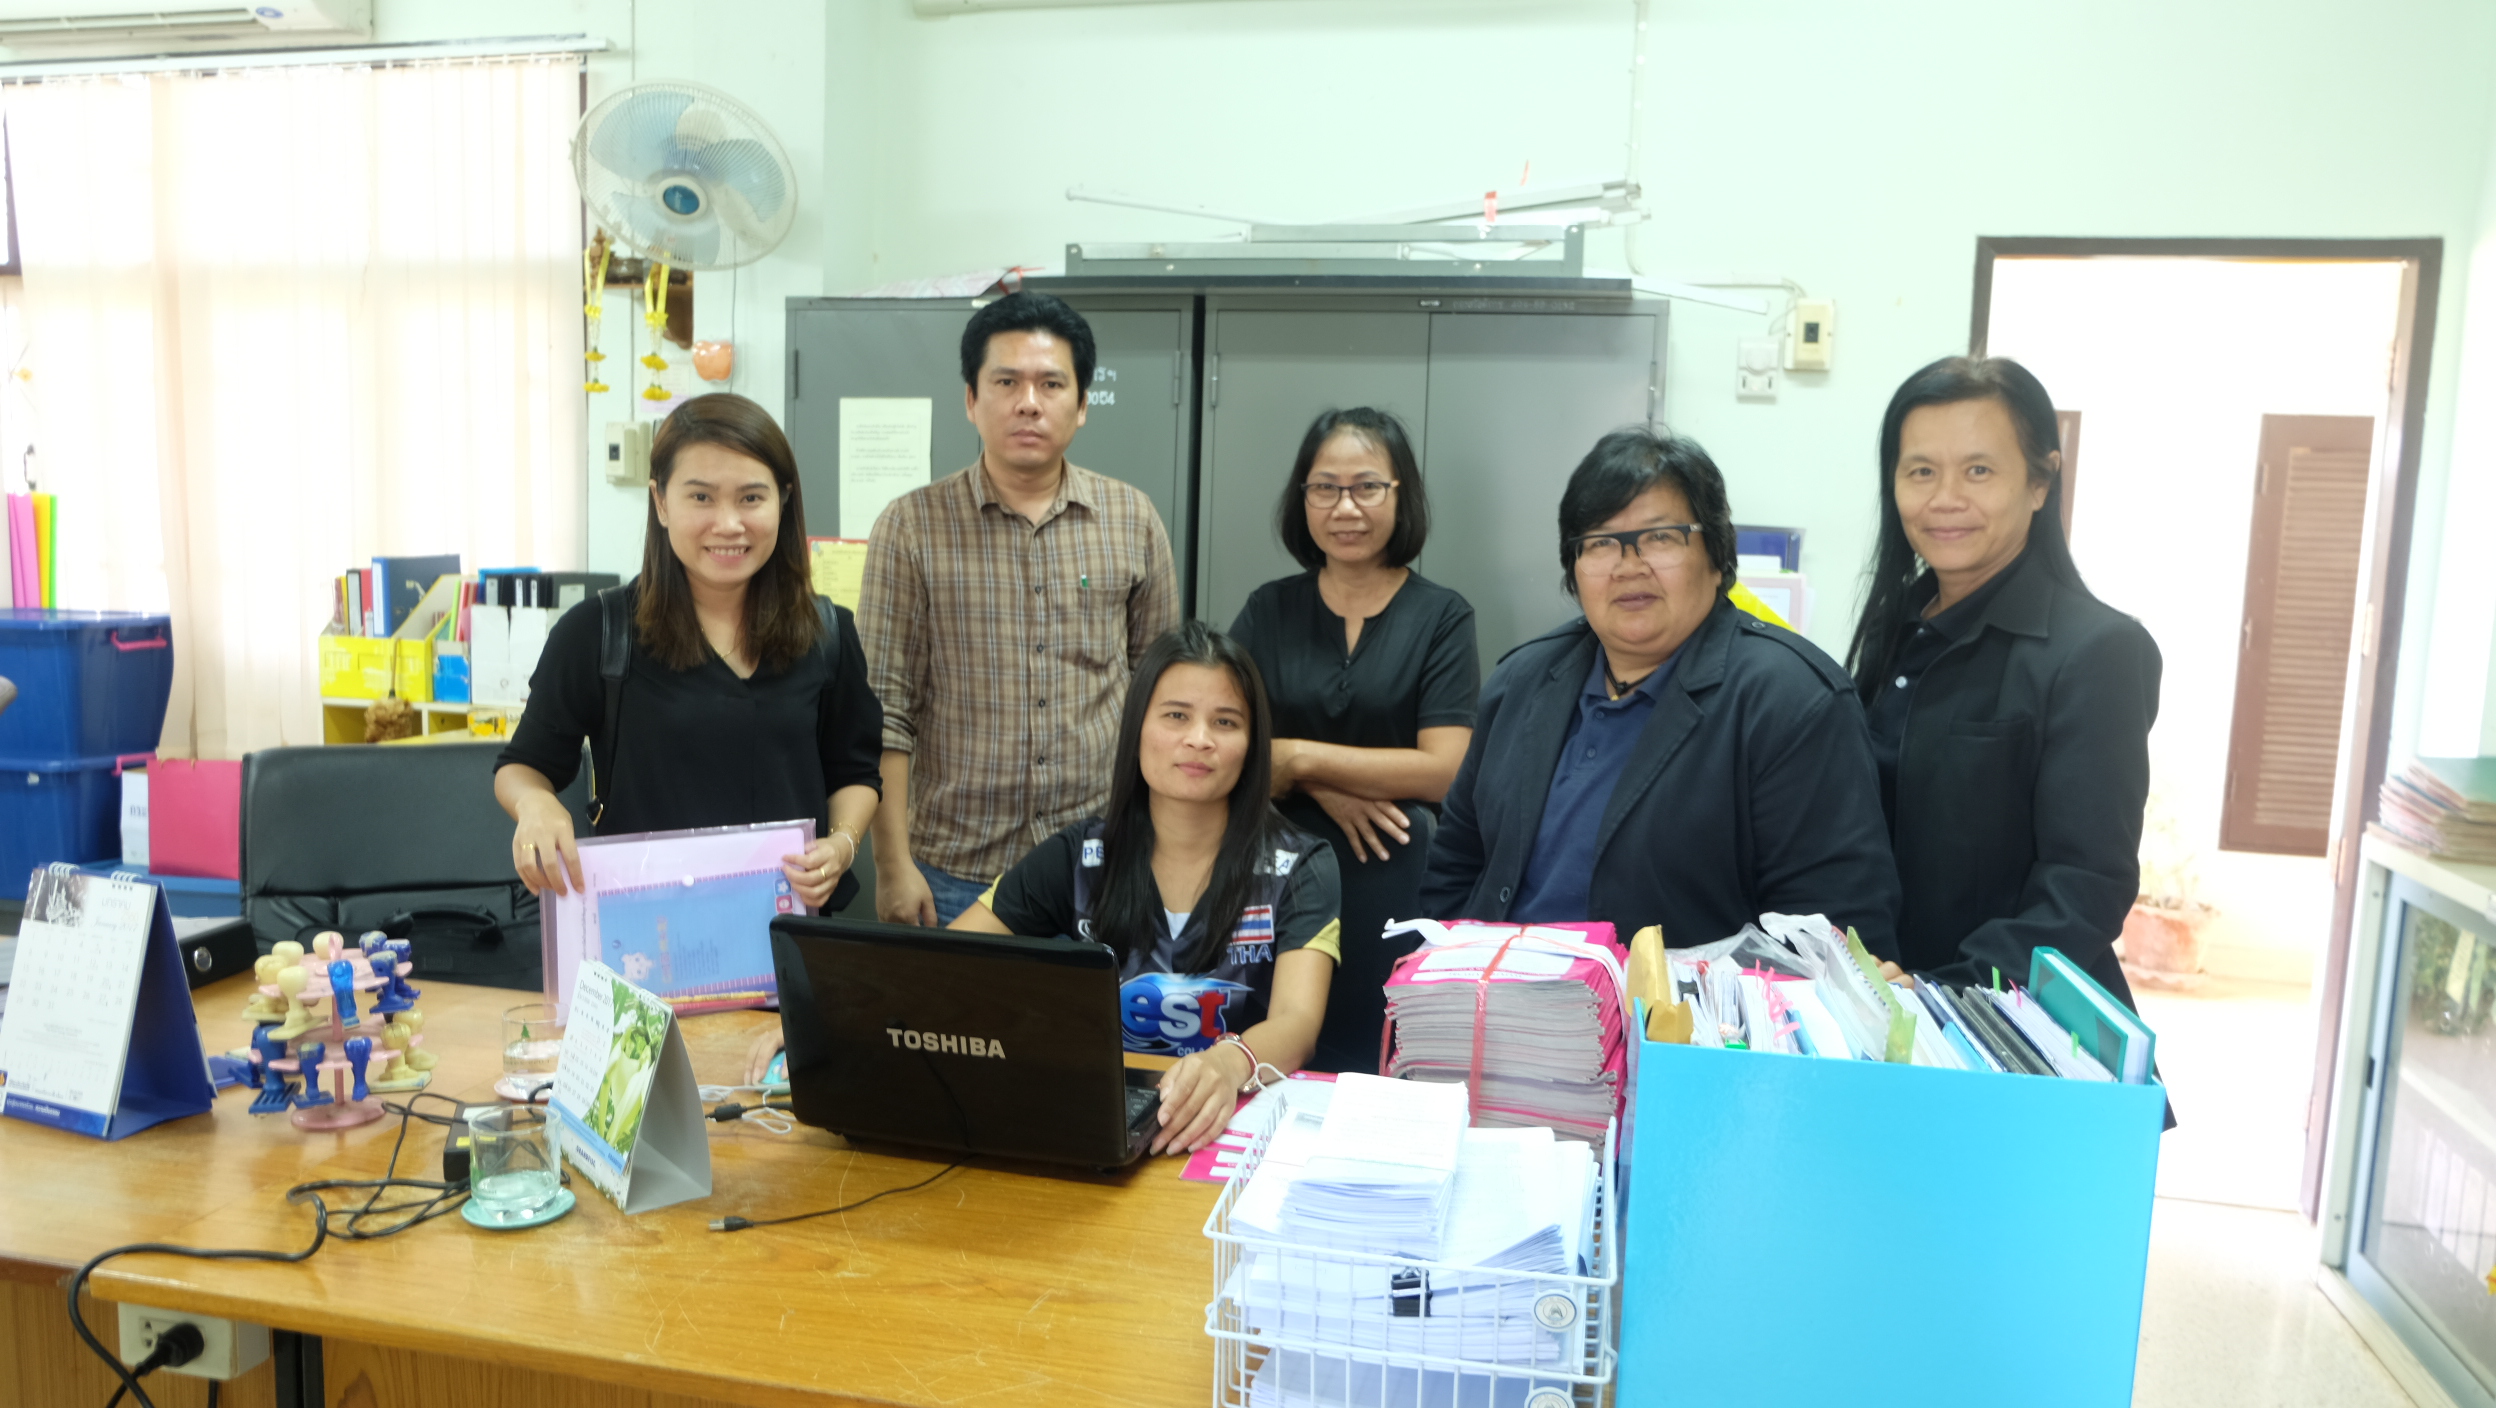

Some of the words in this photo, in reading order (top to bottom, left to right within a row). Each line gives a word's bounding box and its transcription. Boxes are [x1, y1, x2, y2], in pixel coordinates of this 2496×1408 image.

[1227, 943, 1273, 966] THA
[579, 979, 603, 1001] December
[1120, 981, 1226, 1039] est
[886, 1027, 1006, 1060] TOSHIBA
